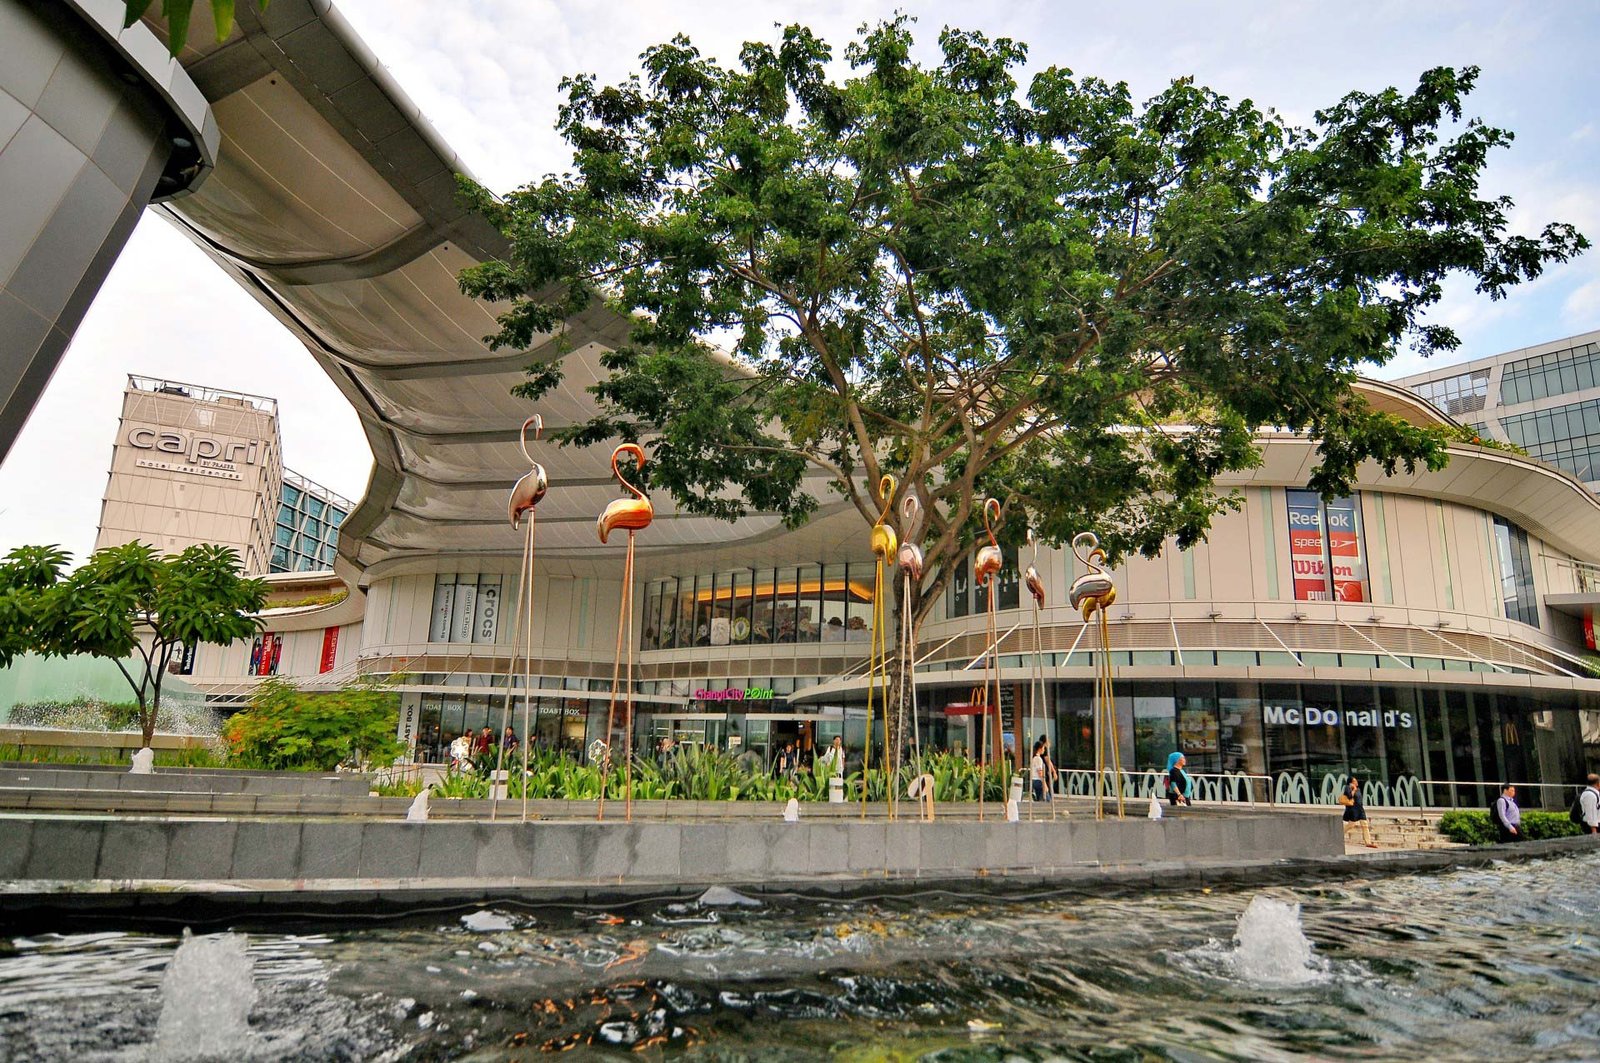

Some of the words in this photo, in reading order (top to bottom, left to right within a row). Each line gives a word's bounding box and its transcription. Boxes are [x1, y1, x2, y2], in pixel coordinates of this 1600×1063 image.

[127, 427, 258, 464] capri
[140, 460, 171, 470] hotel
[176, 465, 240, 479] residences
[1290, 512, 1349, 527] Reeok
[1294, 538, 1337, 549] speeo
[1294, 560, 1353, 576] Wilon
[482, 589, 496, 638] crocs
[1264, 706, 1412, 728] McDonald's
